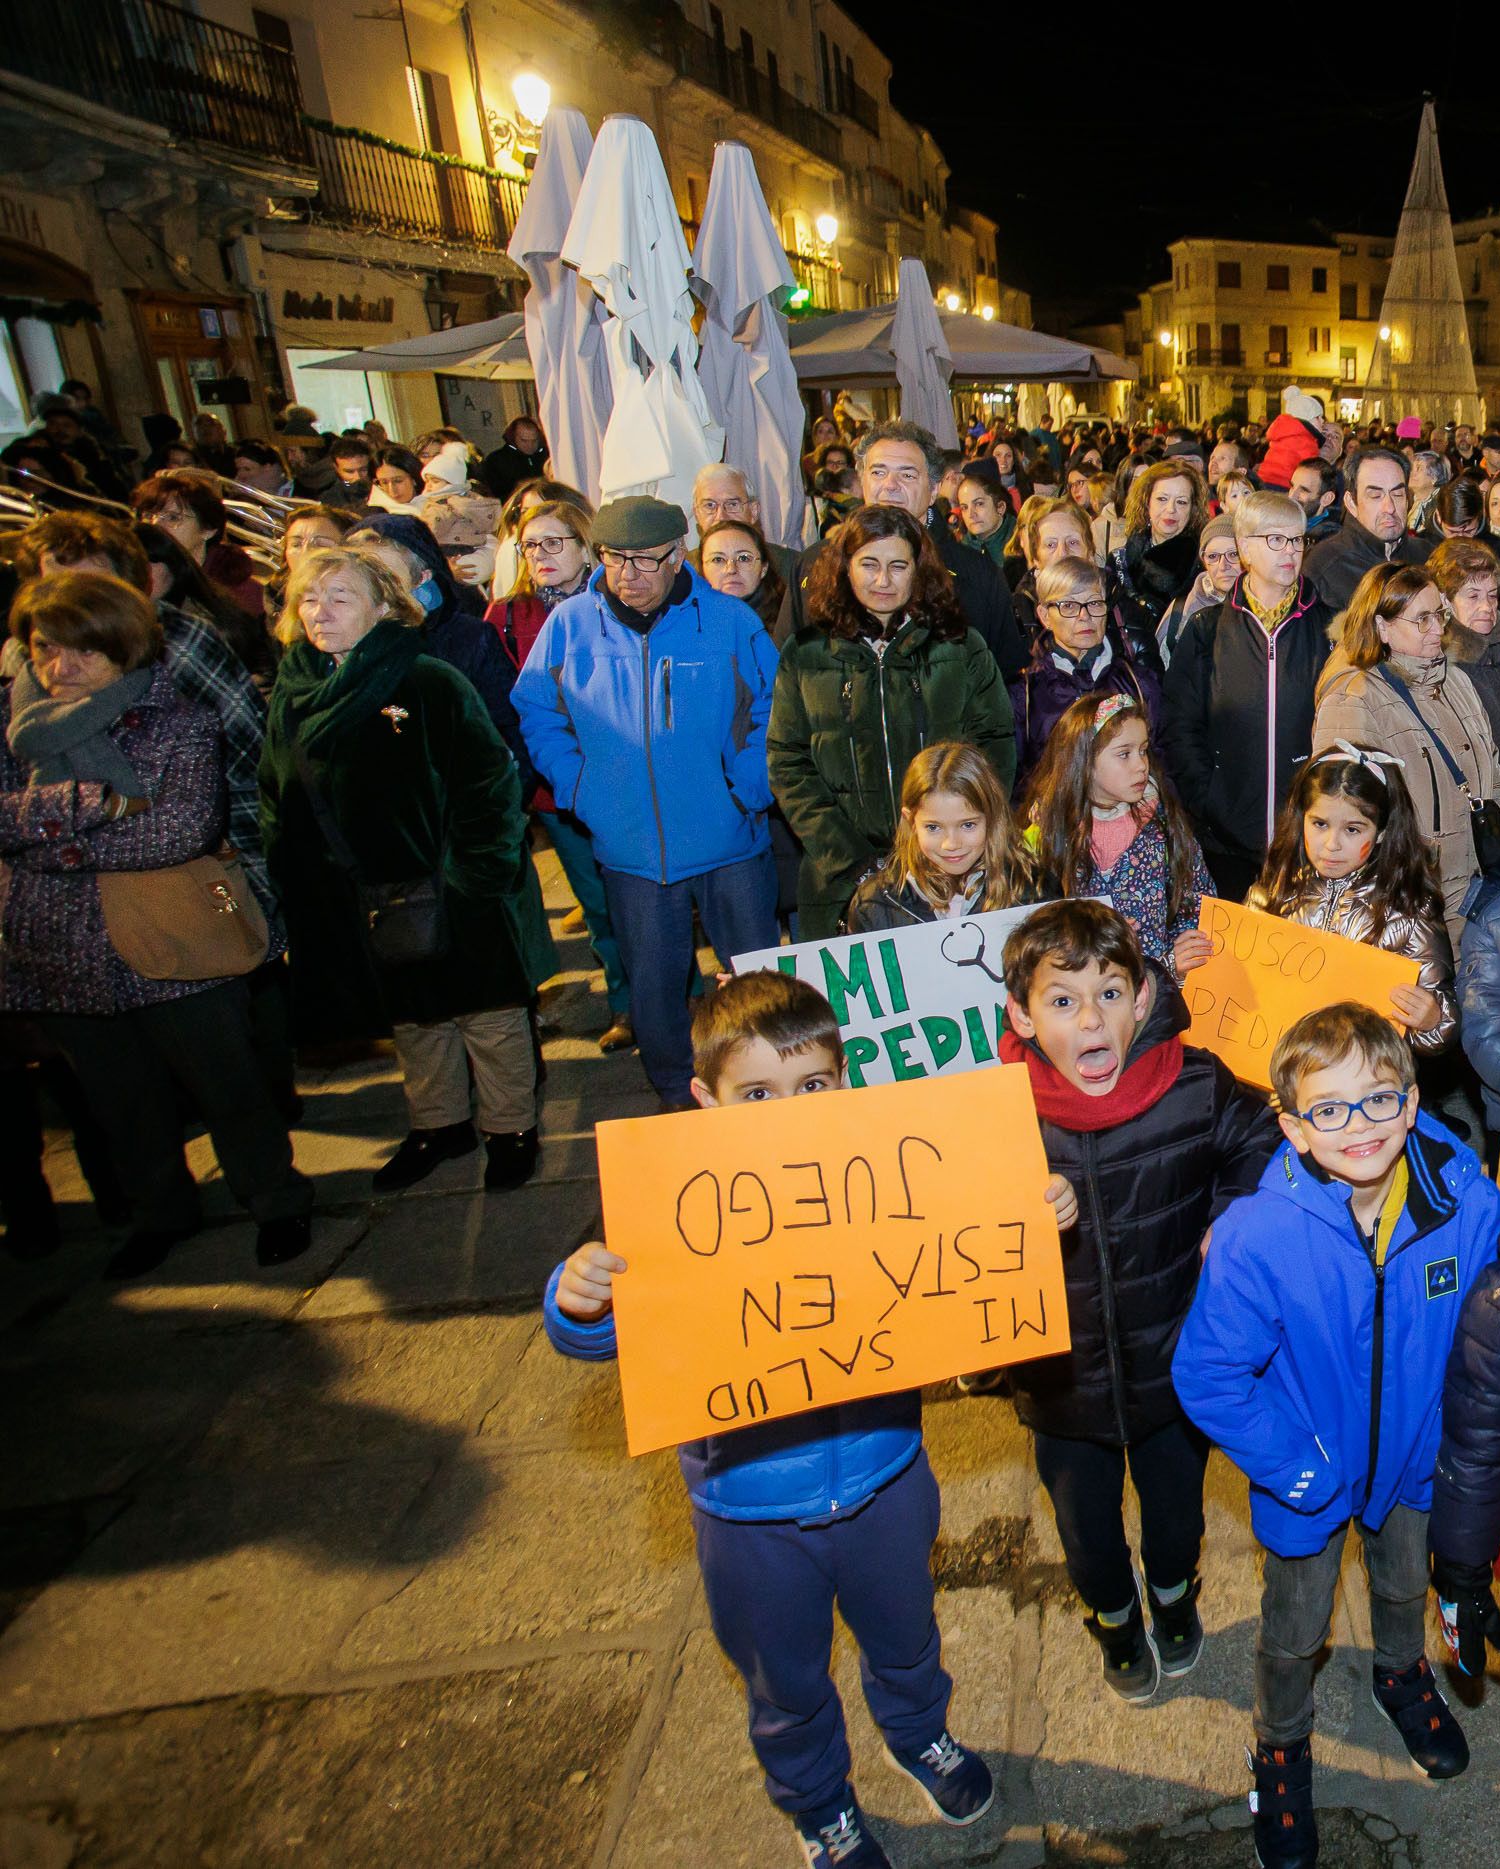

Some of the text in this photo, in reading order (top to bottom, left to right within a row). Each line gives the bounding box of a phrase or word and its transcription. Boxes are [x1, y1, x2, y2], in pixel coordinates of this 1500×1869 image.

[818, 938, 910, 1027] MI
[1209, 904, 1326, 983] BUSCO
[676, 1135, 942, 1256] JUEGO
[741, 1222, 1026, 1348] ESTÁ EN
[707, 1289, 1047, 1421] MI SALUD
